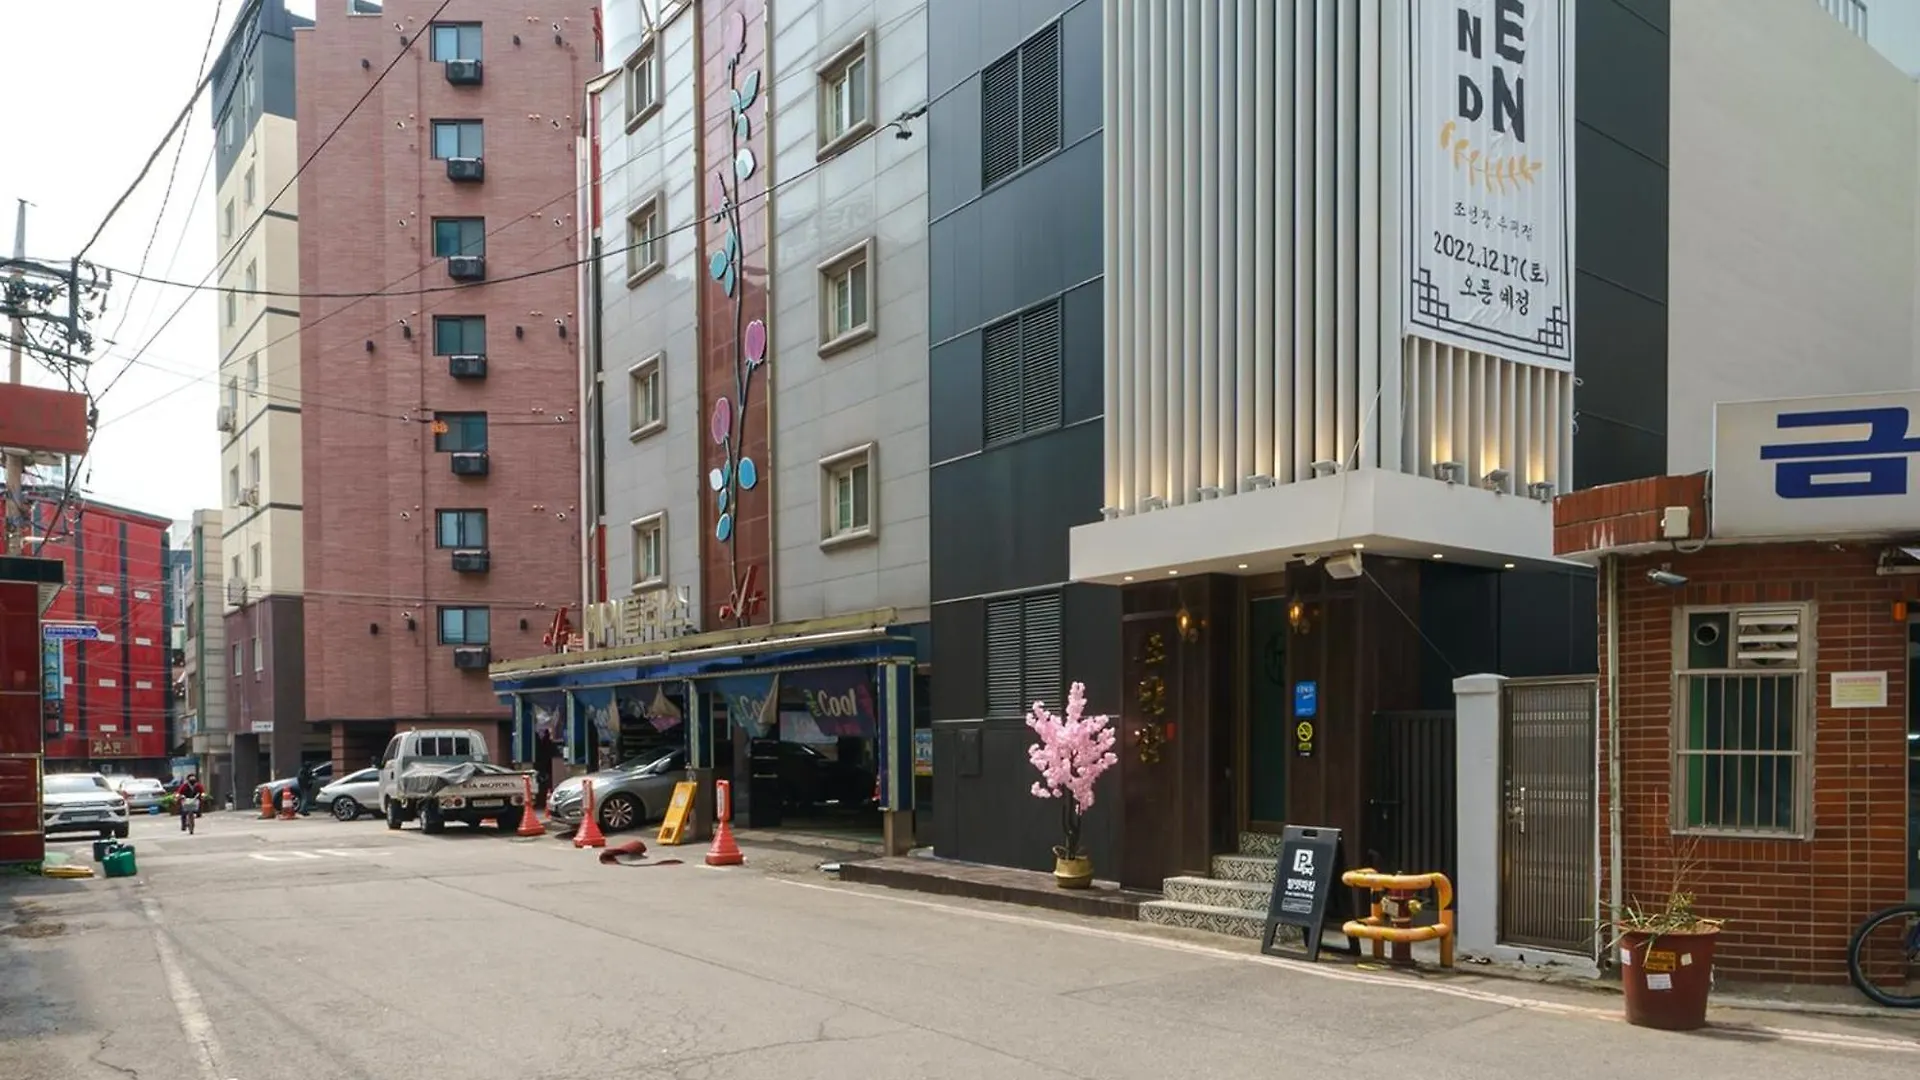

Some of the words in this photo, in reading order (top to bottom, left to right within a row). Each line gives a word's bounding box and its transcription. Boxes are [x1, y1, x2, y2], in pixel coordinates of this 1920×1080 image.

[1500, 285, 1530, 316] 예정
[1760, 406, 1920, 499] 금
[817, 688, 858, 717] Cool
